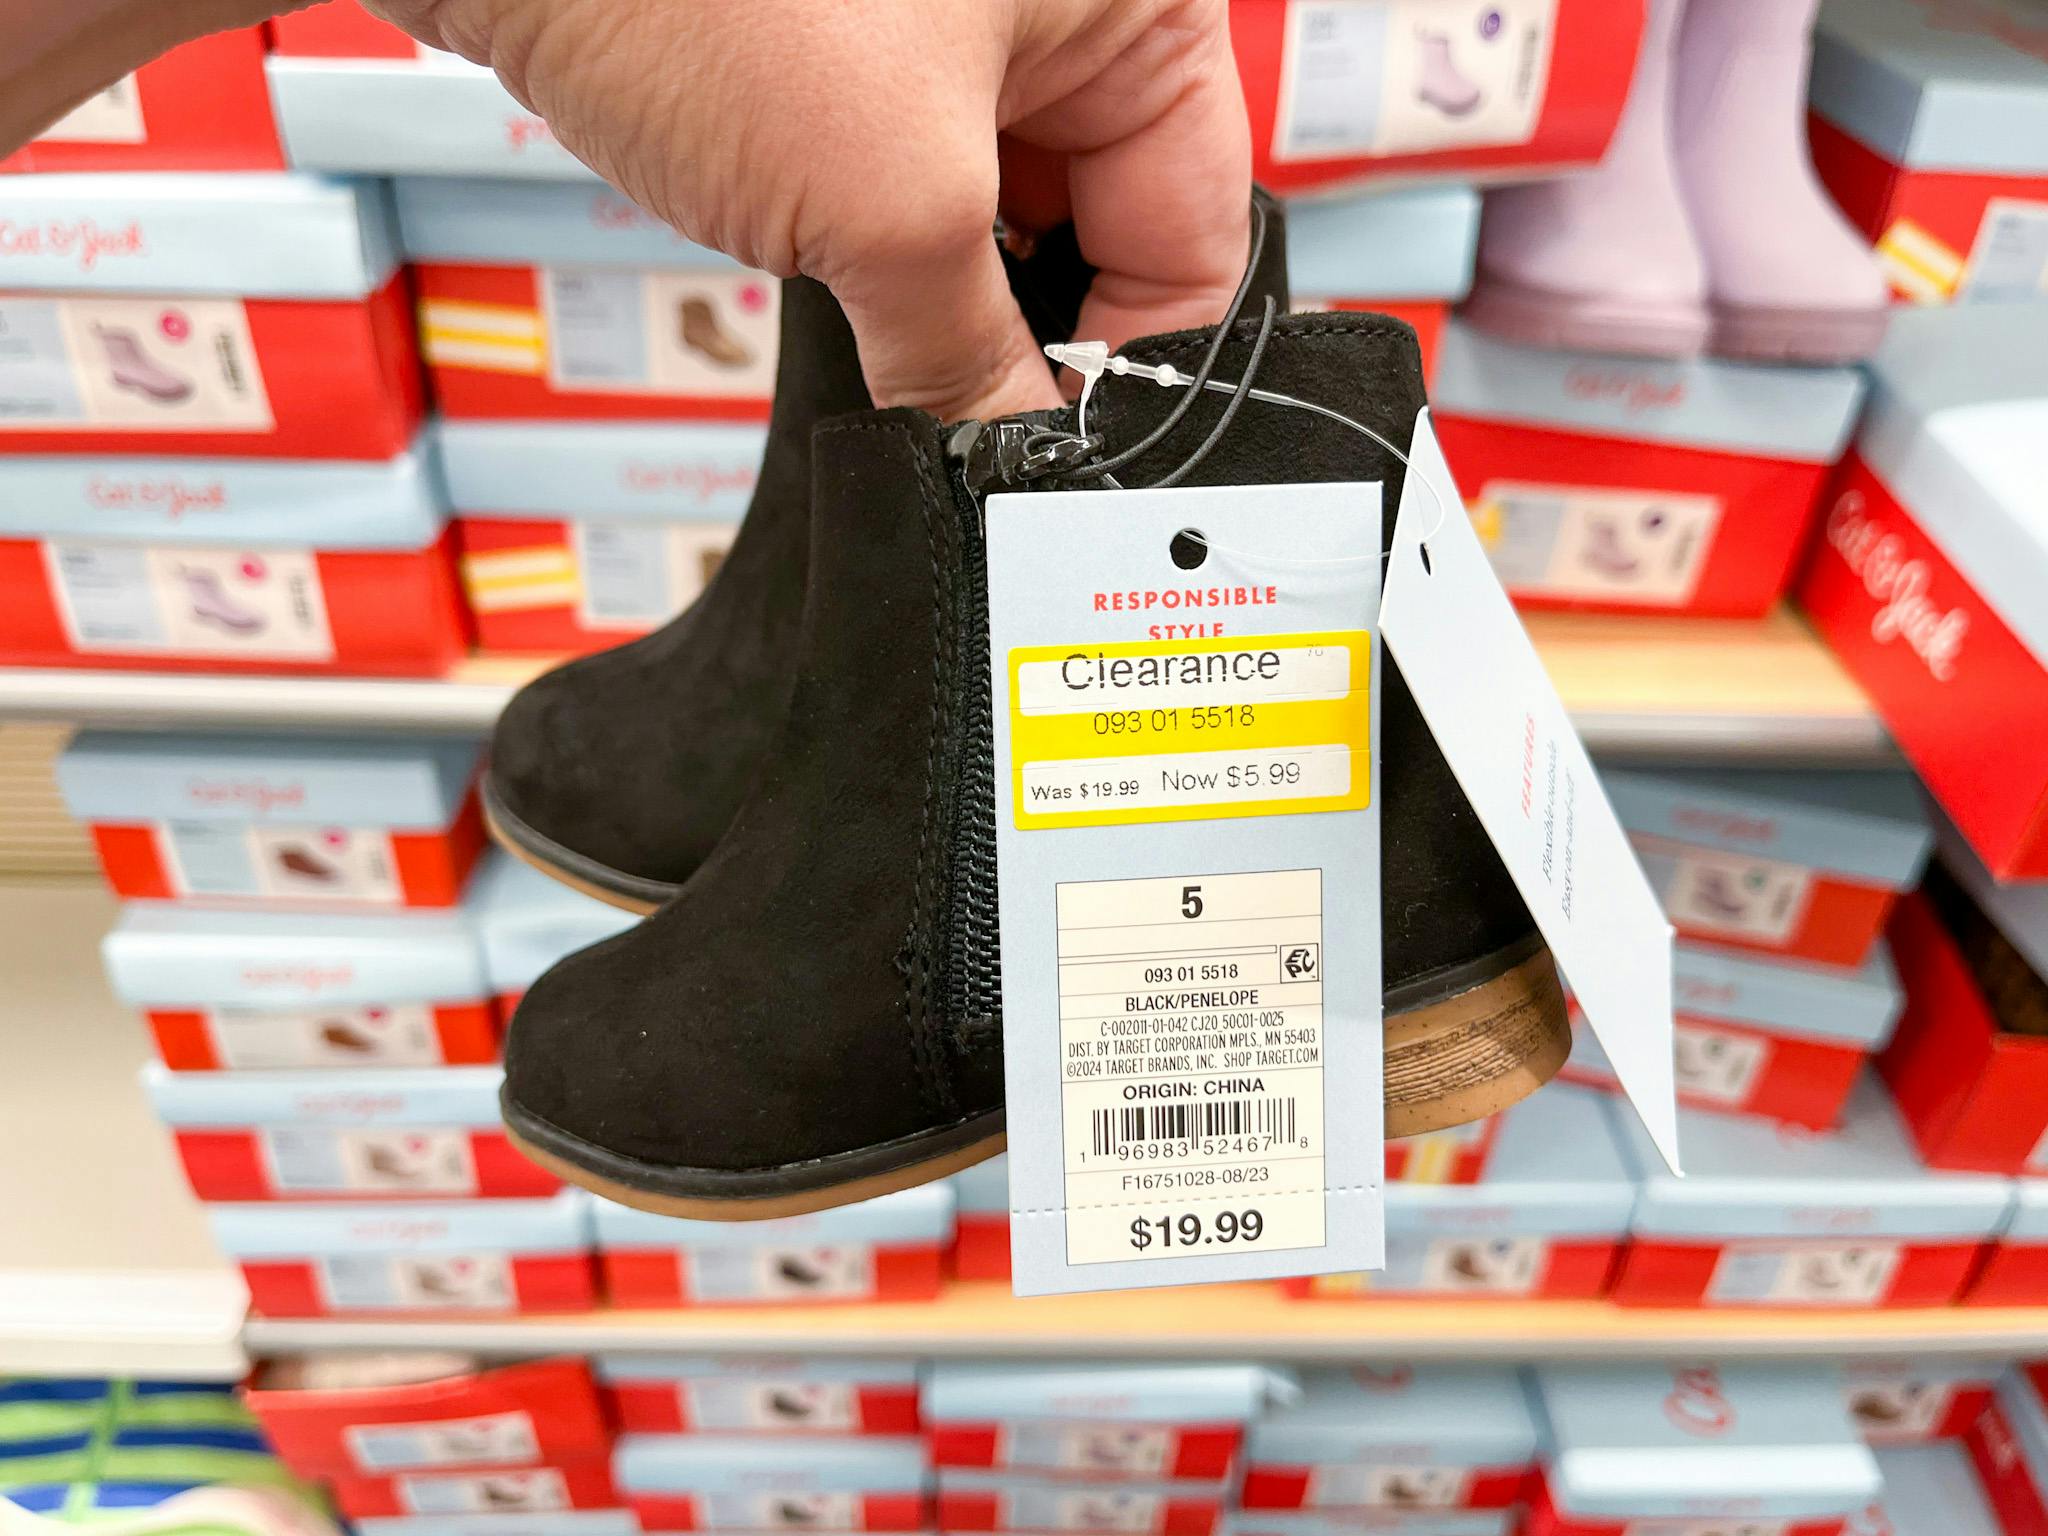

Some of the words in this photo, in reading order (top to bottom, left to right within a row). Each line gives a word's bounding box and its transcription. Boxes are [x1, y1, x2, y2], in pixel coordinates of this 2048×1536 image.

[1094, 585, 1278, 612] RESPONSIBLE
[1149, 622, 1224, 641] STYLE
[1061, 650, 1281, 691] Clearance
[1093, 711, 1143, 736] 093
[1151, 708, 1179, 733] 01
[1190, 704, 1255, 730] 5518
[1031, 784, 1072, 801] Was
[1079, 780, 1140, 799] $19.99
[1162, 769, 1218, 793] Now
[1226, 762, 1301, 790] $5.99
[1181, 885, 1204, 919] 5
[1144, 968, 1173, 984] 093
[1178, 966, 1195, 981] 01
[1201, 964, 1239, 980] 5518
[1125, 990, 1259, 1012] BLACK/PENELOPE
[1100, 1016, 1188, 1037] C-002011-01-042
[1068, 1042, 1094, 1058] DIST.
[1097, 1041, 1110, 1056] BY
[1113, 1038, 1150, 1055] TARGET
[1154, 1034, 1227, 1053] CORPORATION
[1265, 1030, 1281, 1046] MN
[1284, 1028, 1316, 1045] 55403
[1066, 1060, 1102, 1078] ©2024
[1105, 1057, 1144, 1075] TARGET
[1148, 1055, 1194, 1072] BRANDS,
[1197, 1053, 1218, 1070] INC.
[1224, 1051, 1252, 1068] SHOP
[1256, 1048, 1319, 1067] TARGET.COM
[1123, 1082, 1197, 1101] ORIGIN:
[1203, 1078, 1265, 1097] CHINA
[1118, 1143, 1190, 1161] 96983
[1203, 1136, 1273, 1156] 52467
[1299, 1136, 1309, 1150] 8
[1121, 1167, 1270, 1191] F16751028-08/23
[1129, 1209, 1264, 1252] $19.99
